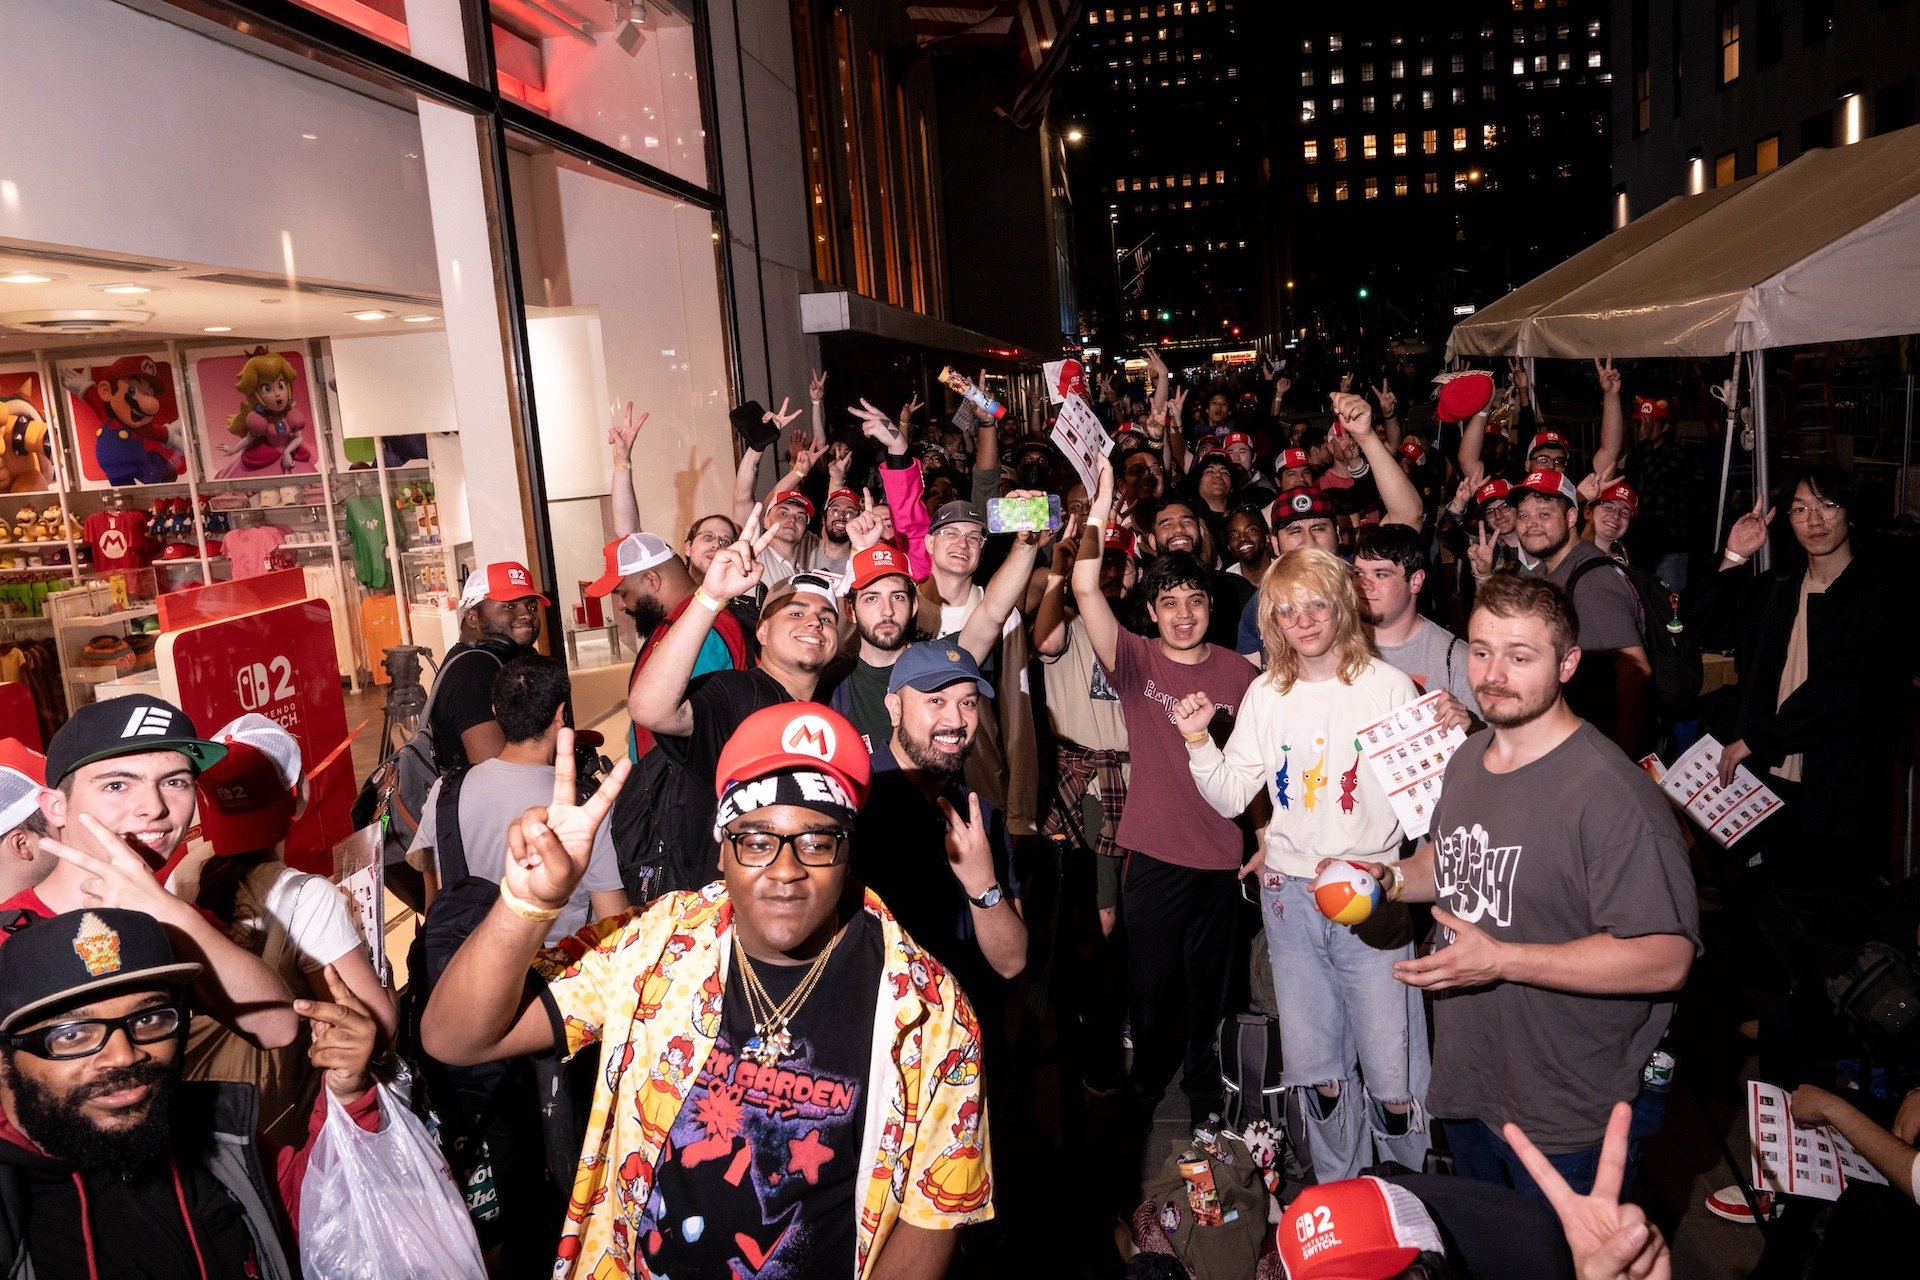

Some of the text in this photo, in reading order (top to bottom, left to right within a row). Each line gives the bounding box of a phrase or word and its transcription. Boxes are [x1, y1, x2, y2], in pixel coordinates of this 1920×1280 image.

[102, 535, 126, 551] M
[269, 655, 296, 701] 2
[264, 702, 296, 719] TENDO
[789, 724, 828, 756] M
[716, 771, 858, 827] EW ER
[705, 1047, 855, 1111] RK GARDEN
[1313, 1205, 1335, 1234] 2
[1303, 1238, 1337, 1260] SWITCH
